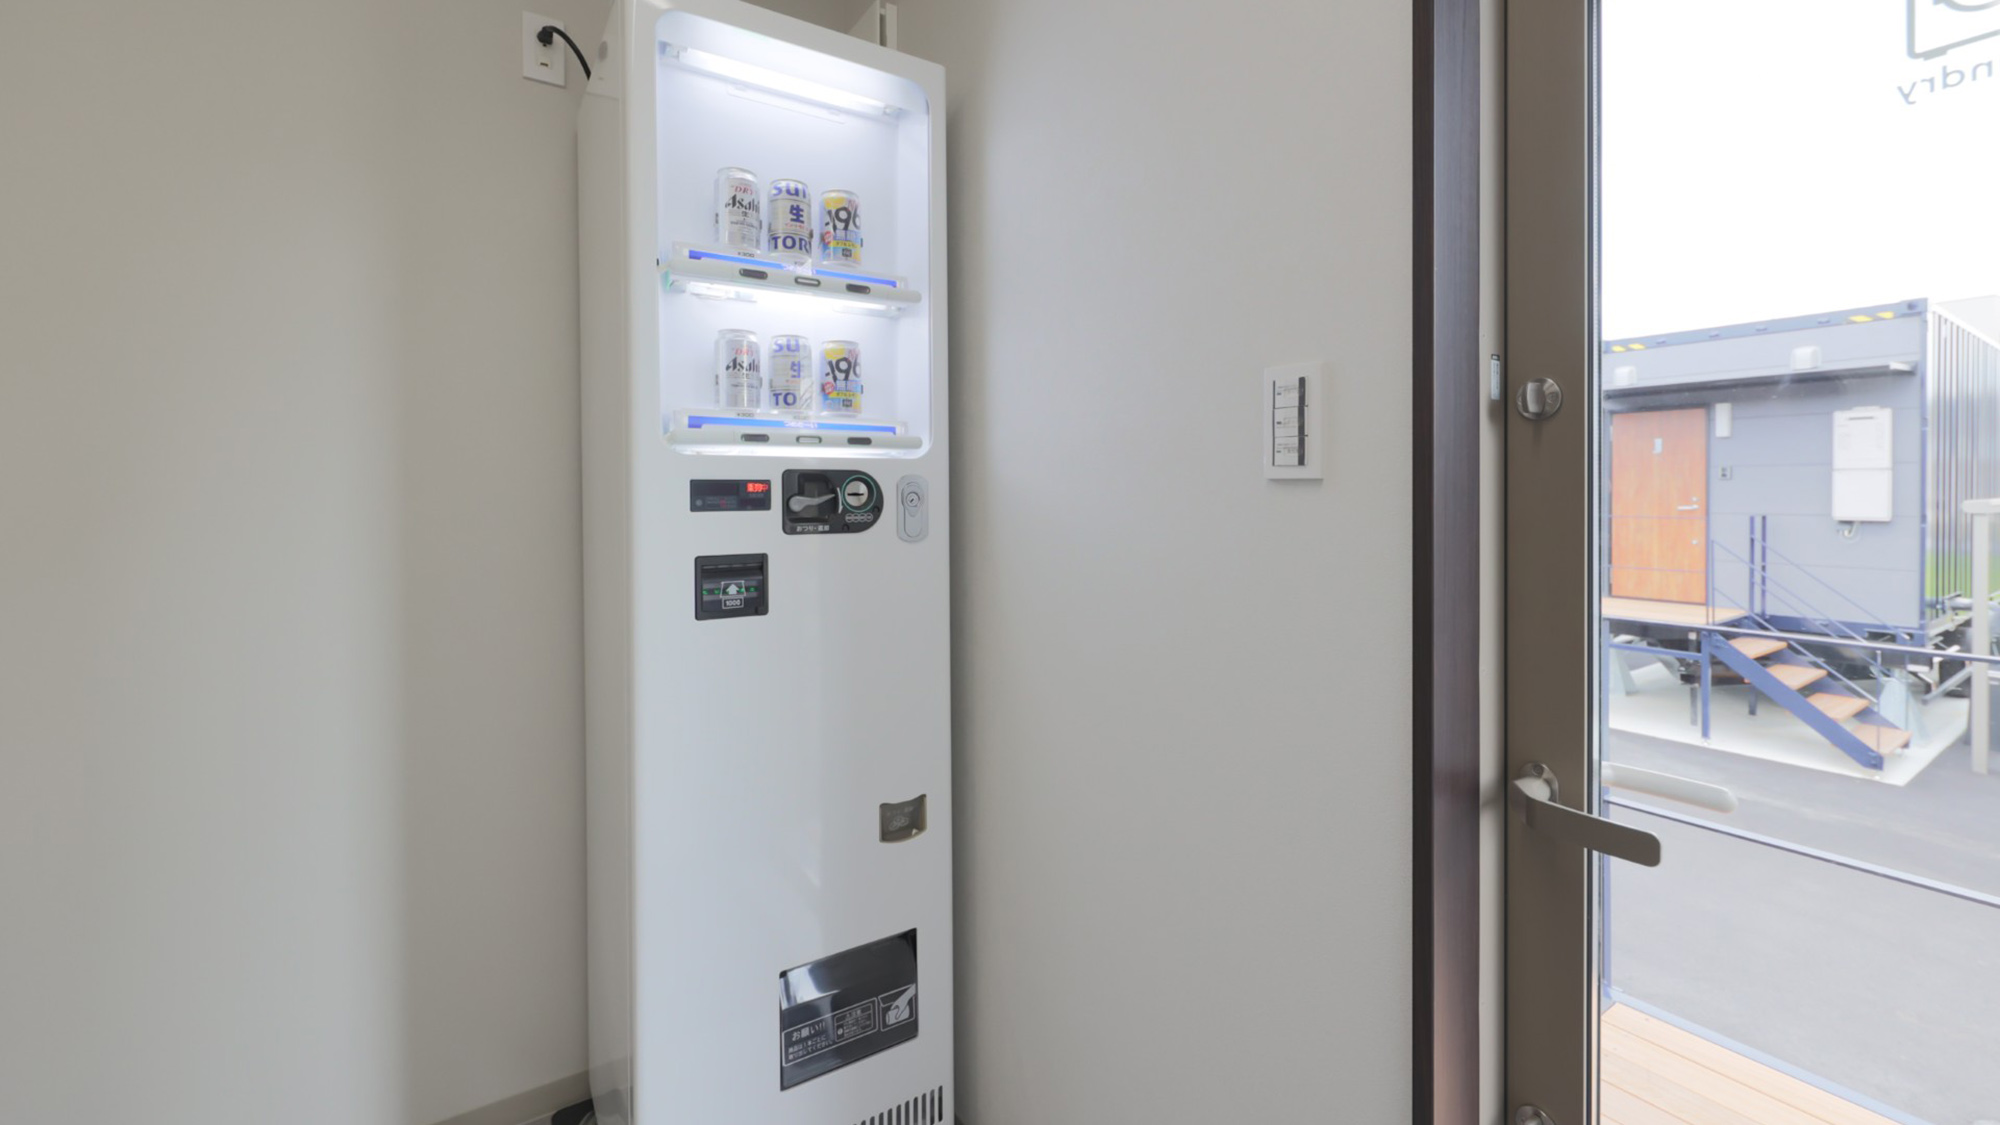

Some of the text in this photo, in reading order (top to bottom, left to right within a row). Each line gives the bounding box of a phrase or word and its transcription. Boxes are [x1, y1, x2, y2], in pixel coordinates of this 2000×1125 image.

[725, 193, 760, 214] Asahi
[789, 204, 804, 224] 生
[773, 337, 800, 353] SU
[772, 391, 797, 407] TO
